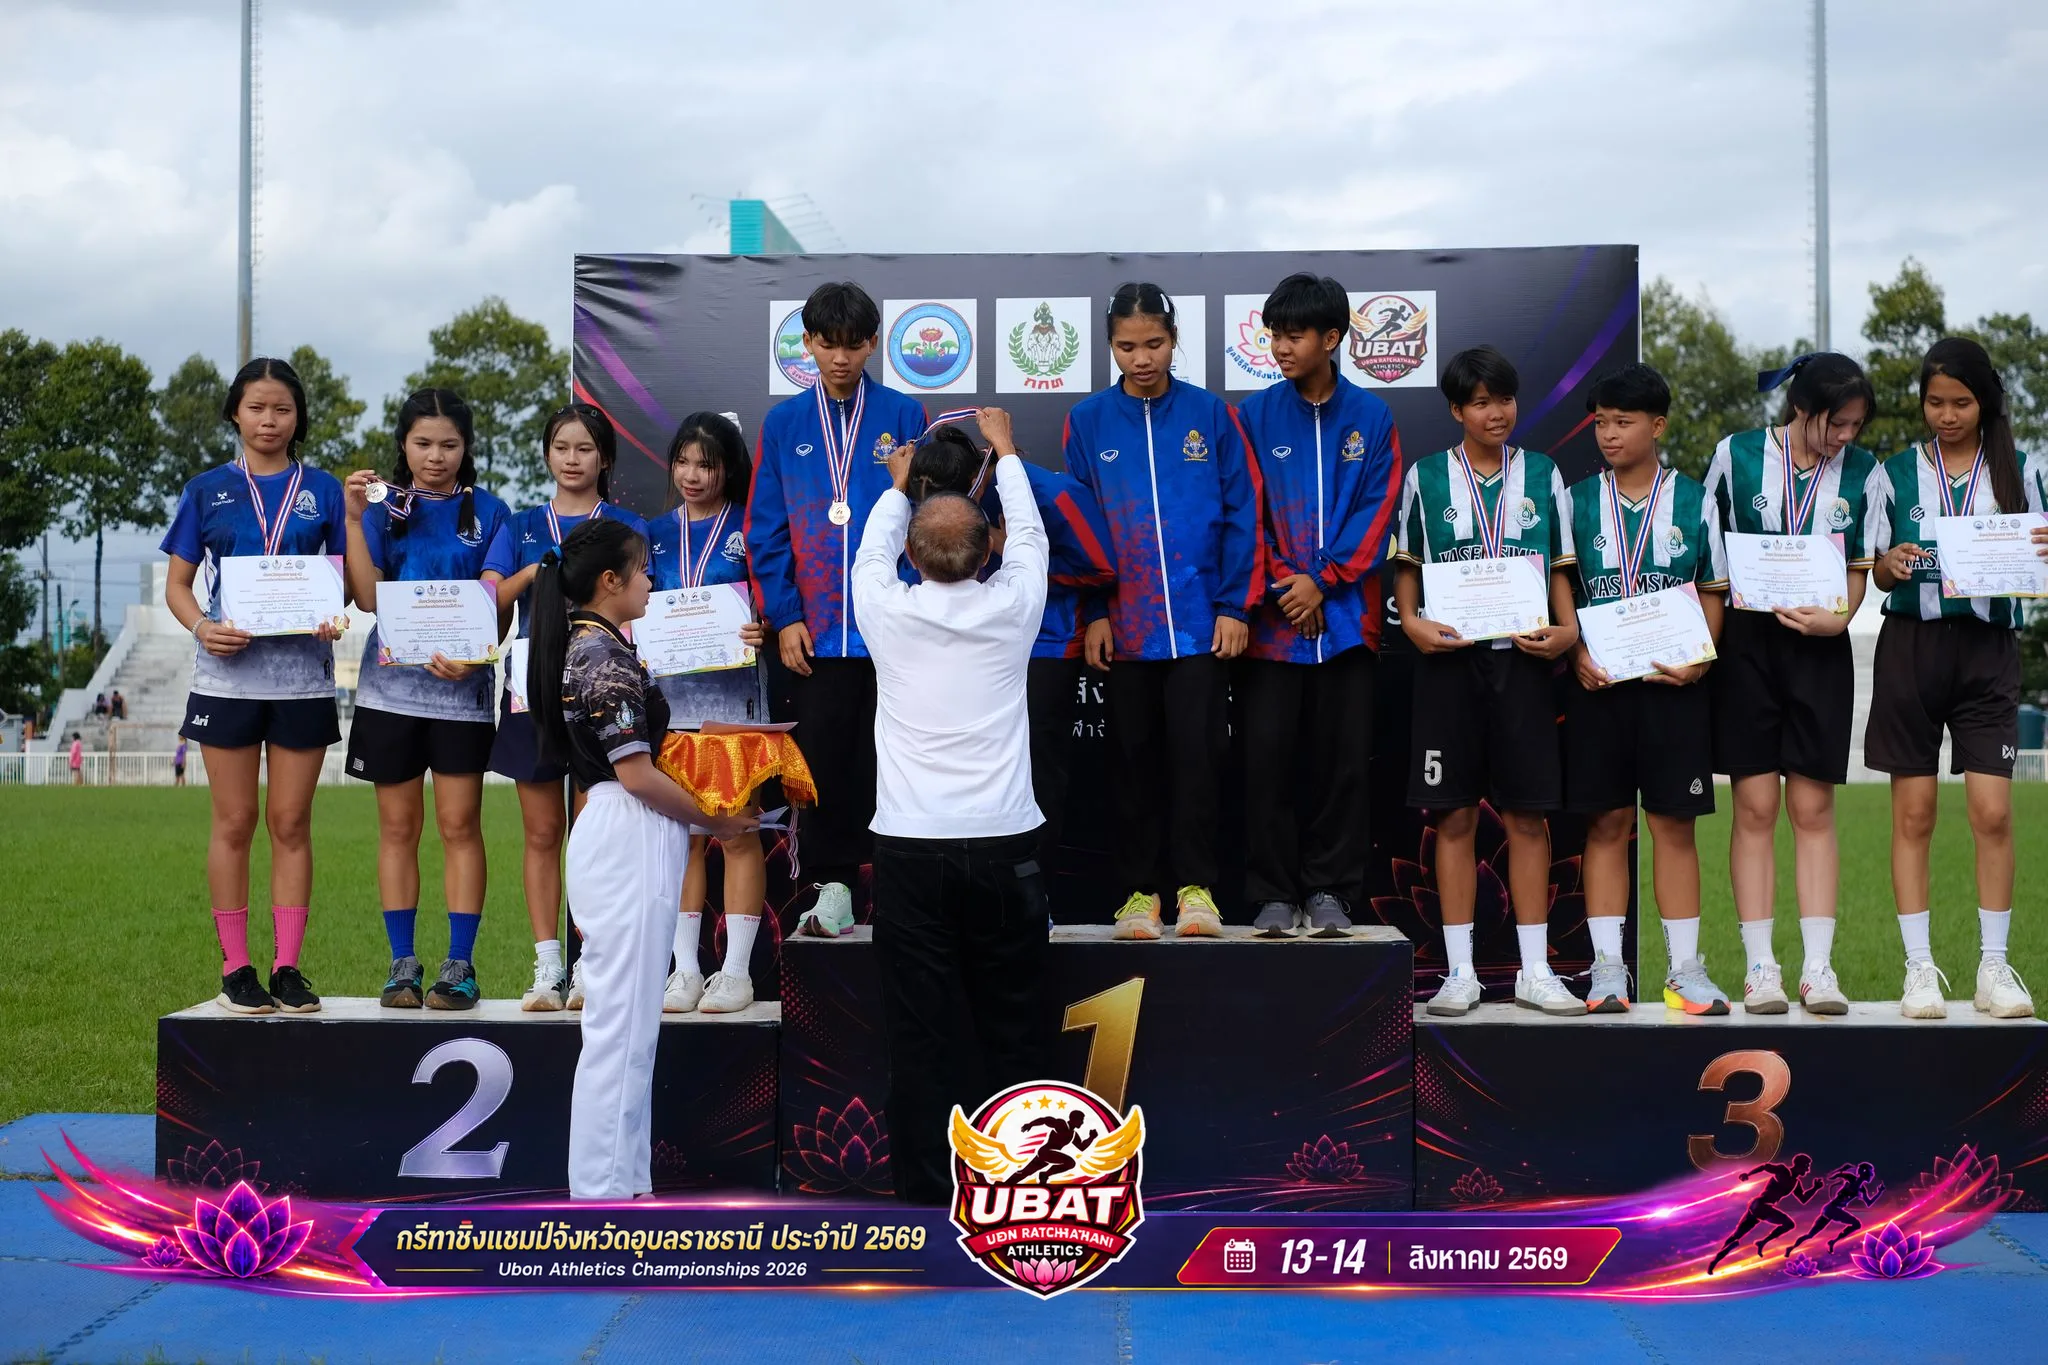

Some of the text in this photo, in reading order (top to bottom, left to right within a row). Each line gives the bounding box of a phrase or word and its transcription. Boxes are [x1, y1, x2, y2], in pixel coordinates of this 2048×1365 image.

[1355, 340, 1421, 358] UBAT
[1023, 376, 1065, 390] กกท
[191, 715, 210, 727] Ari
[1424, 749, 1443, 786] 5
[1062, 977, 1145, 1117] 1
[398, 1038, 514, 1178] 2
[1687, 1049, 1792, 1174] 3
